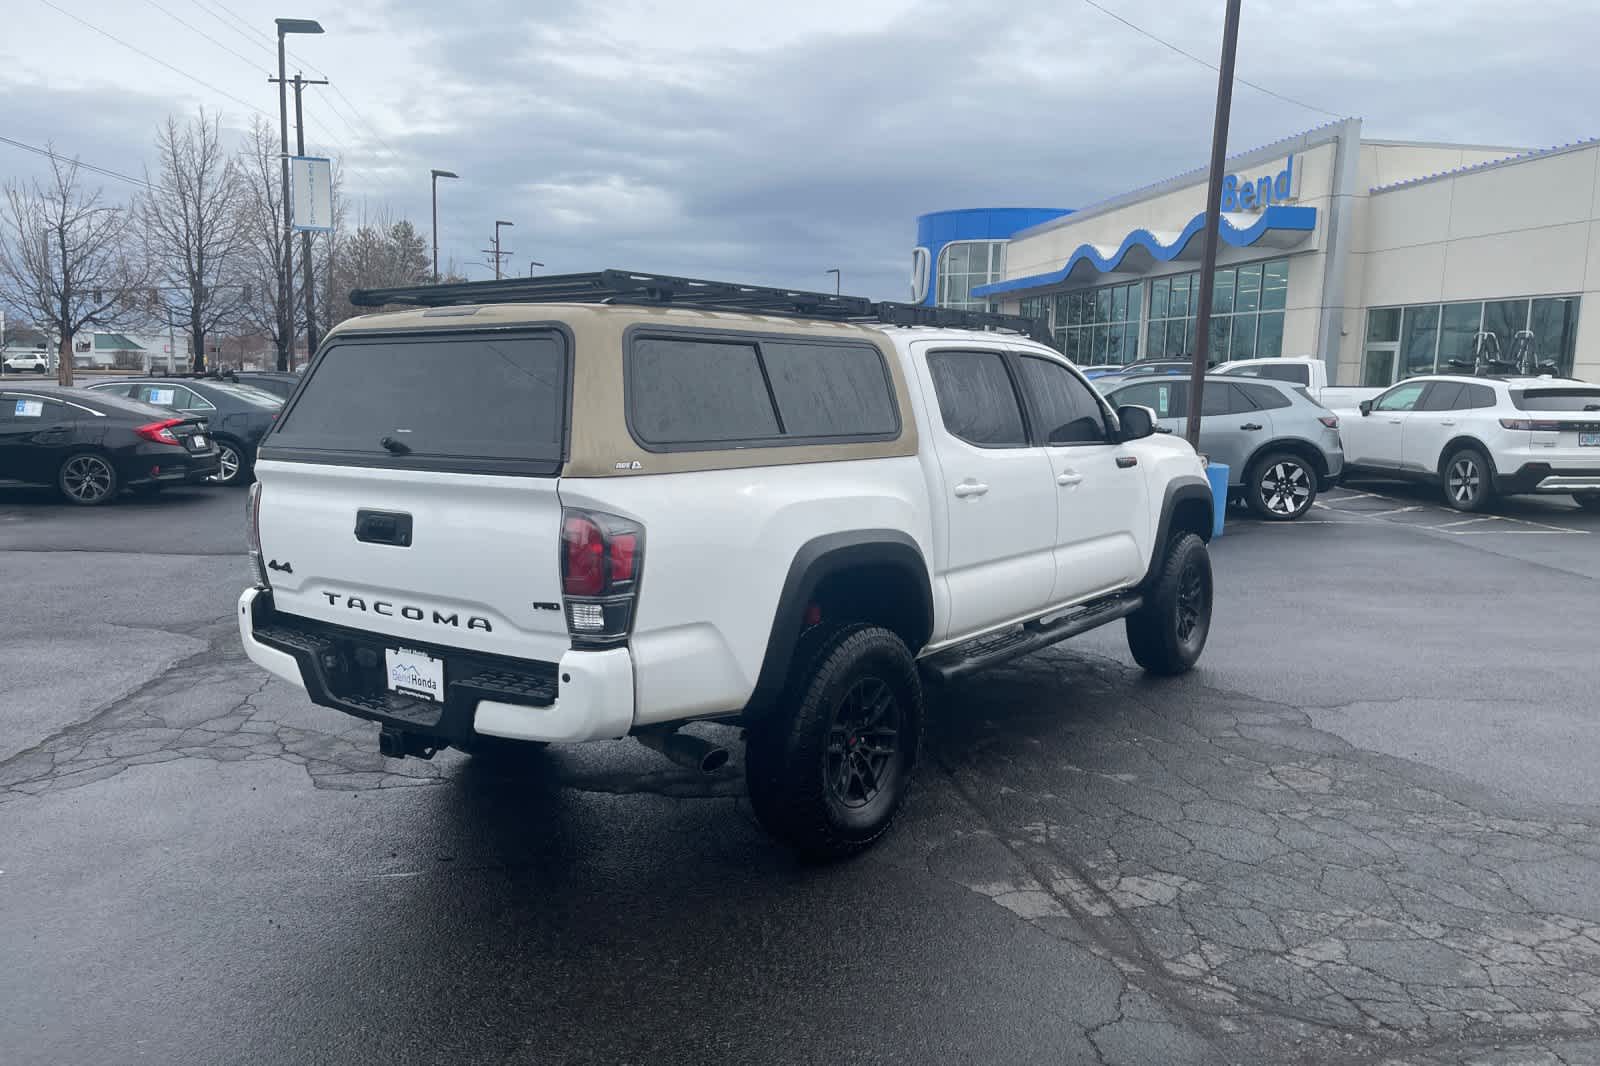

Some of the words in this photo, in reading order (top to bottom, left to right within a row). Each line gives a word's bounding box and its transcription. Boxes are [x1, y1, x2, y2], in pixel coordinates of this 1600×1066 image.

[1220, 153, 1293, 213] Bend
[322, 591, 493, 632] TACOMA
[411, 674, 437, 690] Honda
